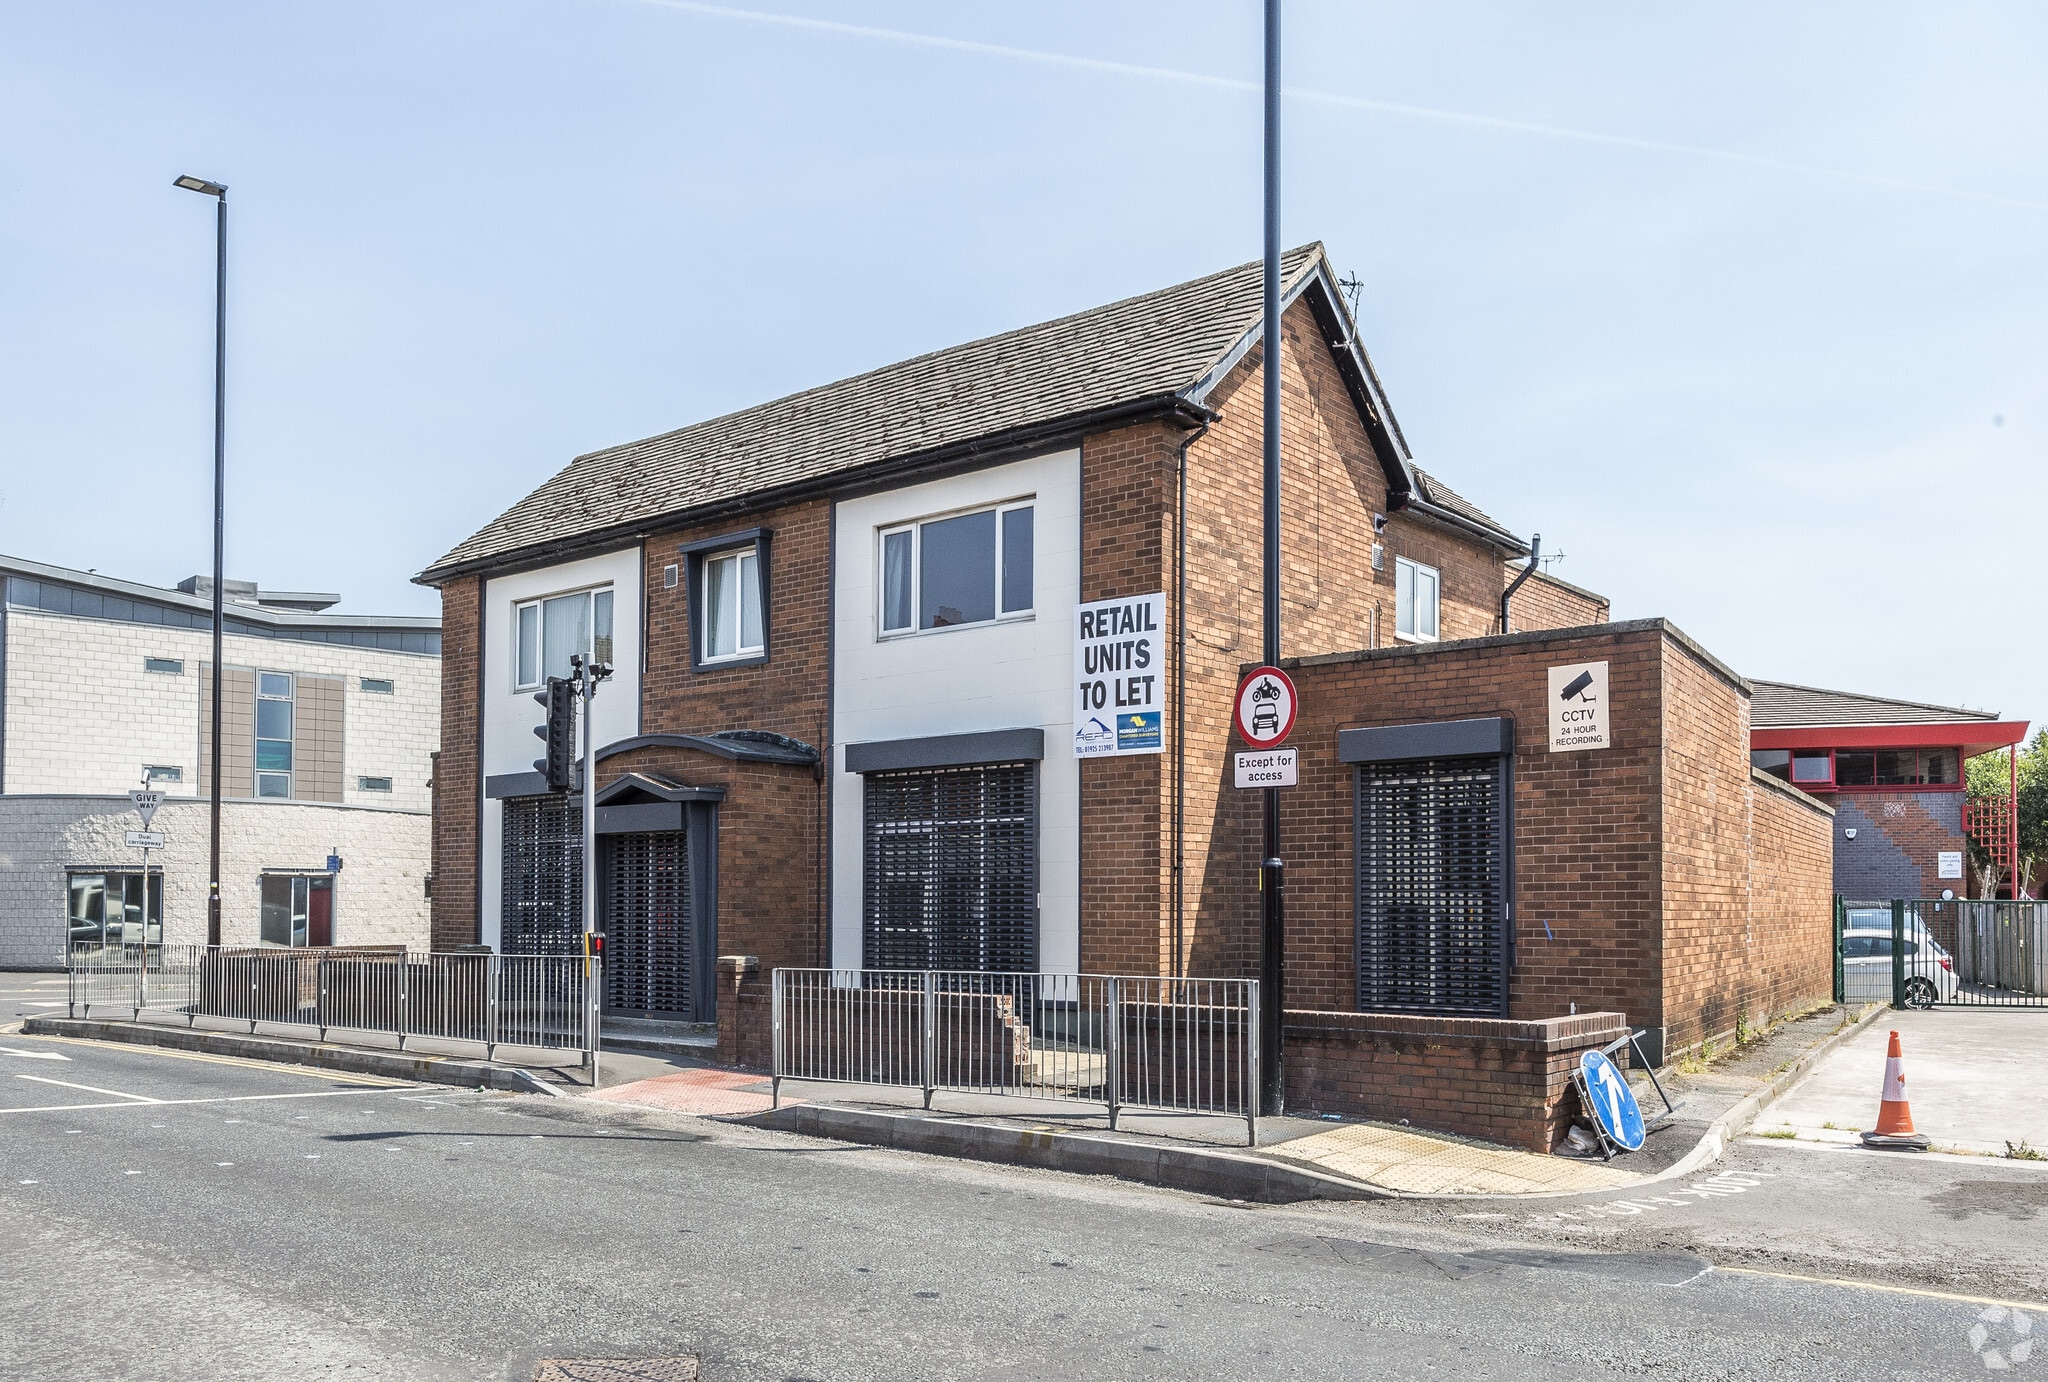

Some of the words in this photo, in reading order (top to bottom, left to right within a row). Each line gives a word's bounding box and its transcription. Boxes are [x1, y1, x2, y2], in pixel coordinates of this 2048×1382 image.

[1081, 603, 1157, 640] RETAIL
[1085, 639, 1151, 675] UNITS
[1080, 680, 1107, 710] TO
[1115, 675, 1155, 707] LET
[1562, 709, 1595, 722] CCTV
[1561, 727, 1570, 735] 24
[1574, 725, 1597, 734] HOUR
[1556, 735, 1602, 746] RECORDING
[1085, 745, 1098, 753] 01925
[1239, 756, 1274, 769] Except
[1277, 755, 1292, 766] for
[1248, 771, 1283, 781] access
[136, 794, 157, 802] GIVE
[1668, 1170, 1776, 1199] LOOK
